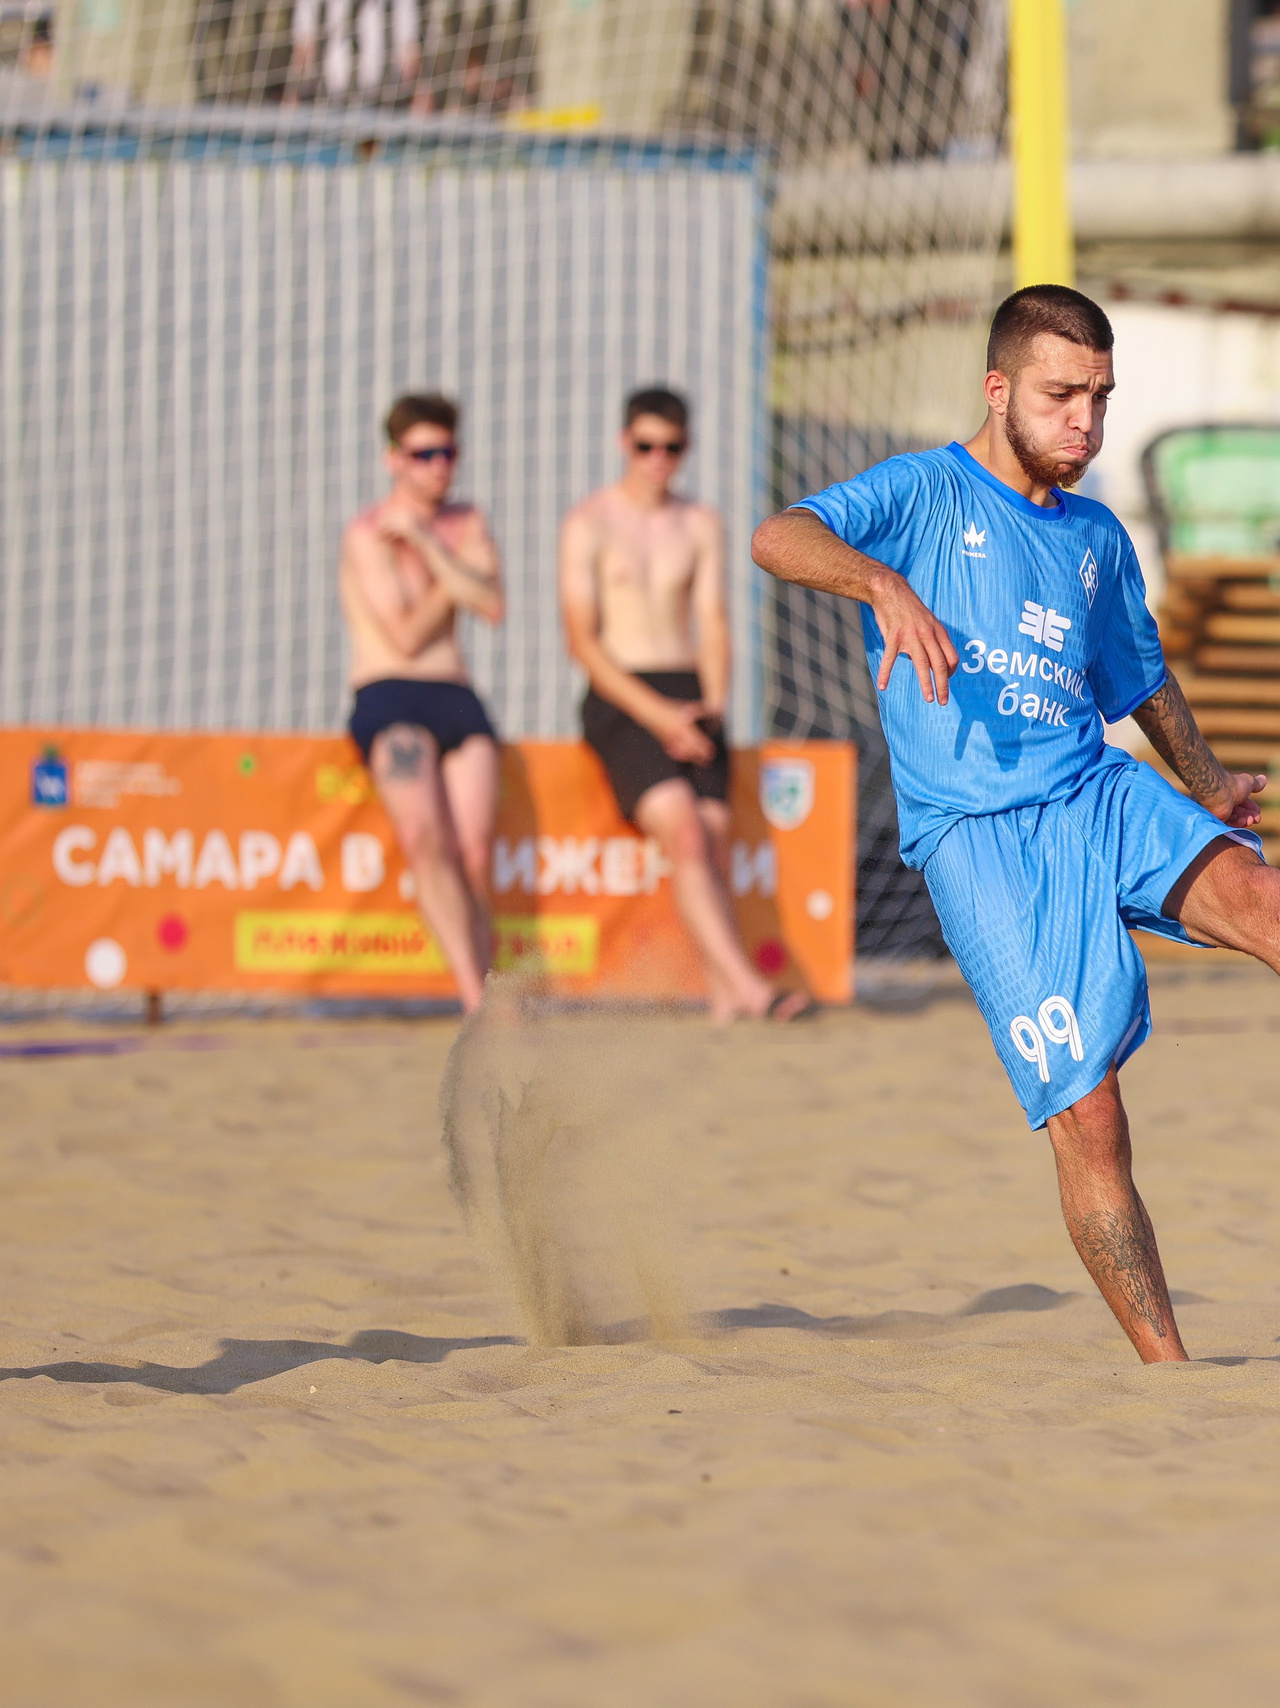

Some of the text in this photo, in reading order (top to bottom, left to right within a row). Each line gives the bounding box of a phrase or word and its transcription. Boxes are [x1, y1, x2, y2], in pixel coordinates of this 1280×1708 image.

[961, 639, 1086, 702] Земский
[997, 682, 1070, 728] банк
[52, 824, 325, 892] САМАРА
[341, 832, 386, 893] В
[1010, 995, 1085, 1084] 99
